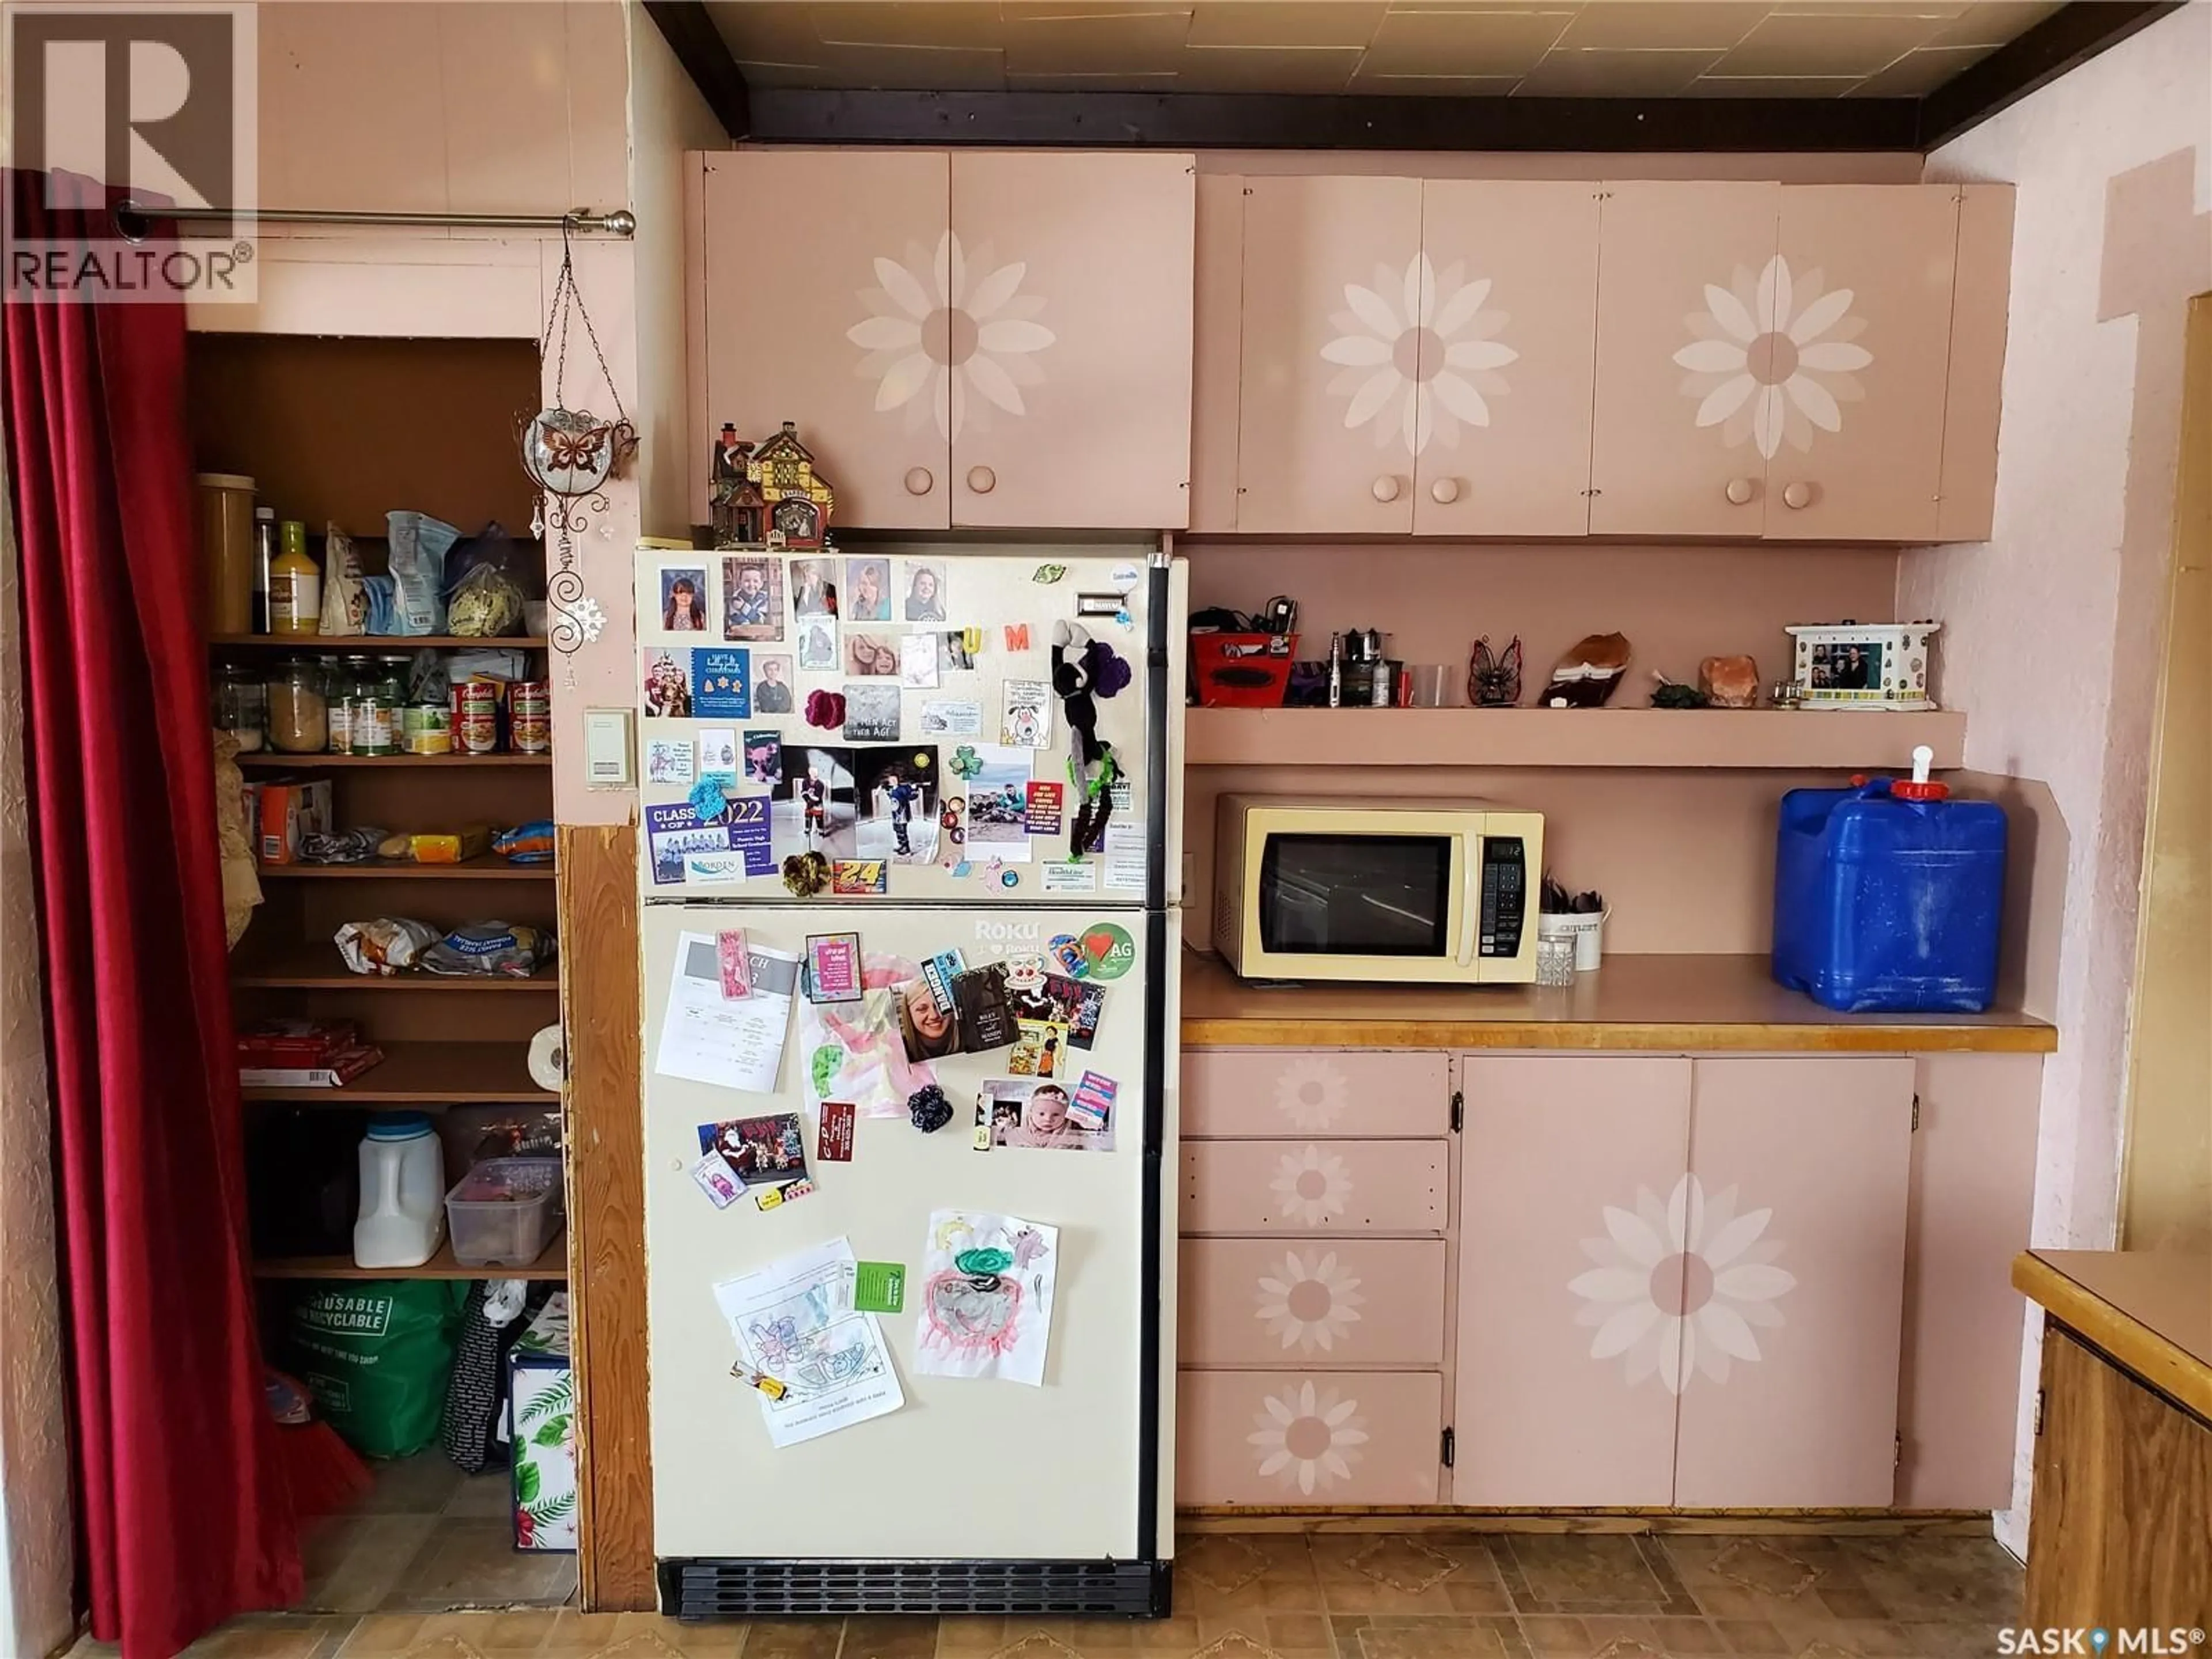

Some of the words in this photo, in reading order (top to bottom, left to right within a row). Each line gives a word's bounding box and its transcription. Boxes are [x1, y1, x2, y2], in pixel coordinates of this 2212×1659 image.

[1005, 624, 1029, 652] M
[654, 808, 696, 822] CLASS
[839, 862, 881, 884] 24
